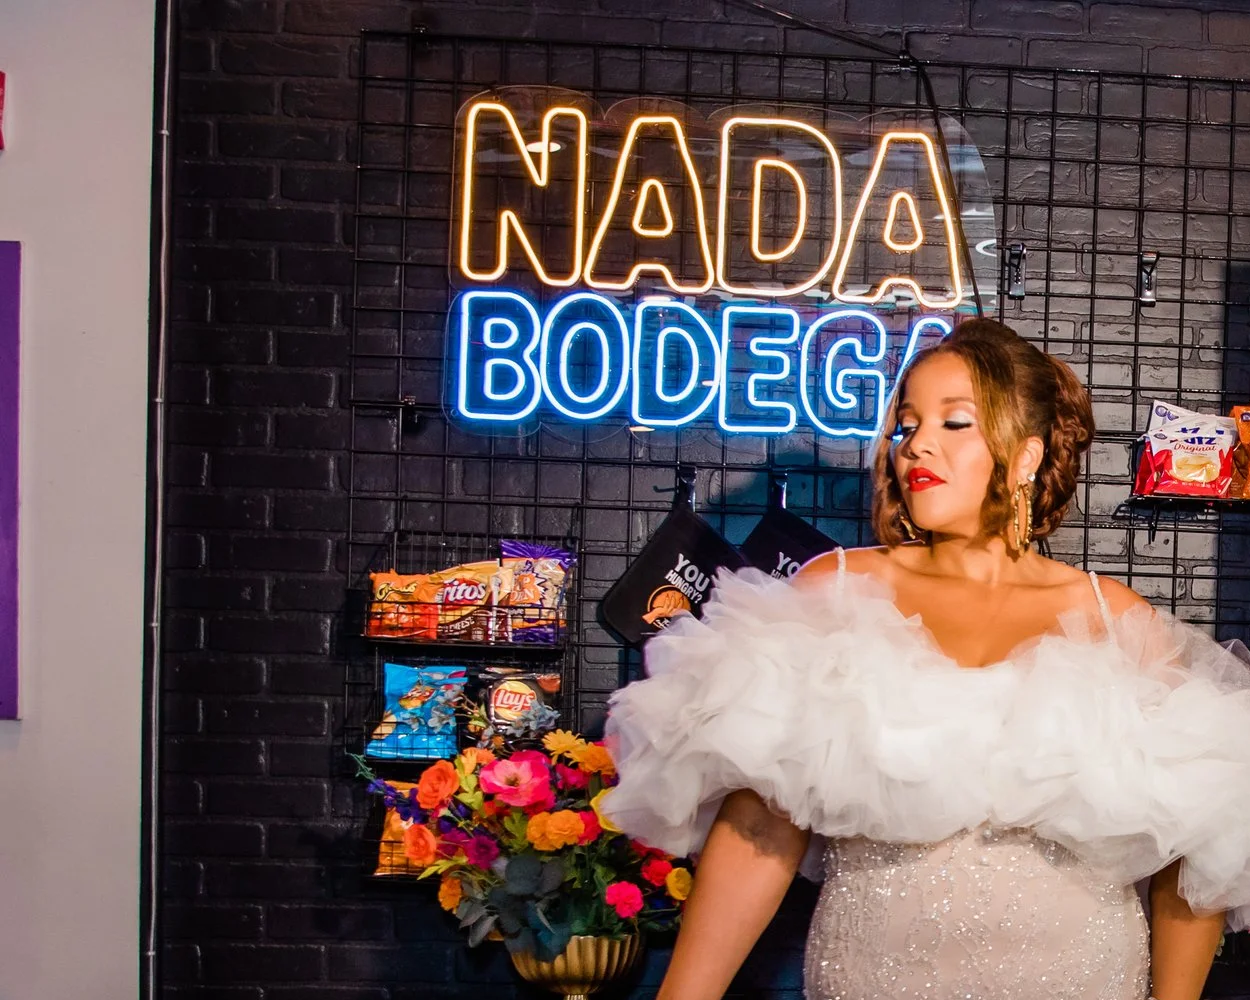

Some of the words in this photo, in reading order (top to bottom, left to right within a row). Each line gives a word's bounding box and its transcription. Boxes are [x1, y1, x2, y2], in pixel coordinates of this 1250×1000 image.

[459, 103, 963, 308] NADA
[1174, 443, 1217, 452] Original
[674, 552, 710, 592] YOU
[775, 552, 801, 579] YO
[441, 578, 486, 602] ritos
[665, 569, 703, 603] HUNGRY?
